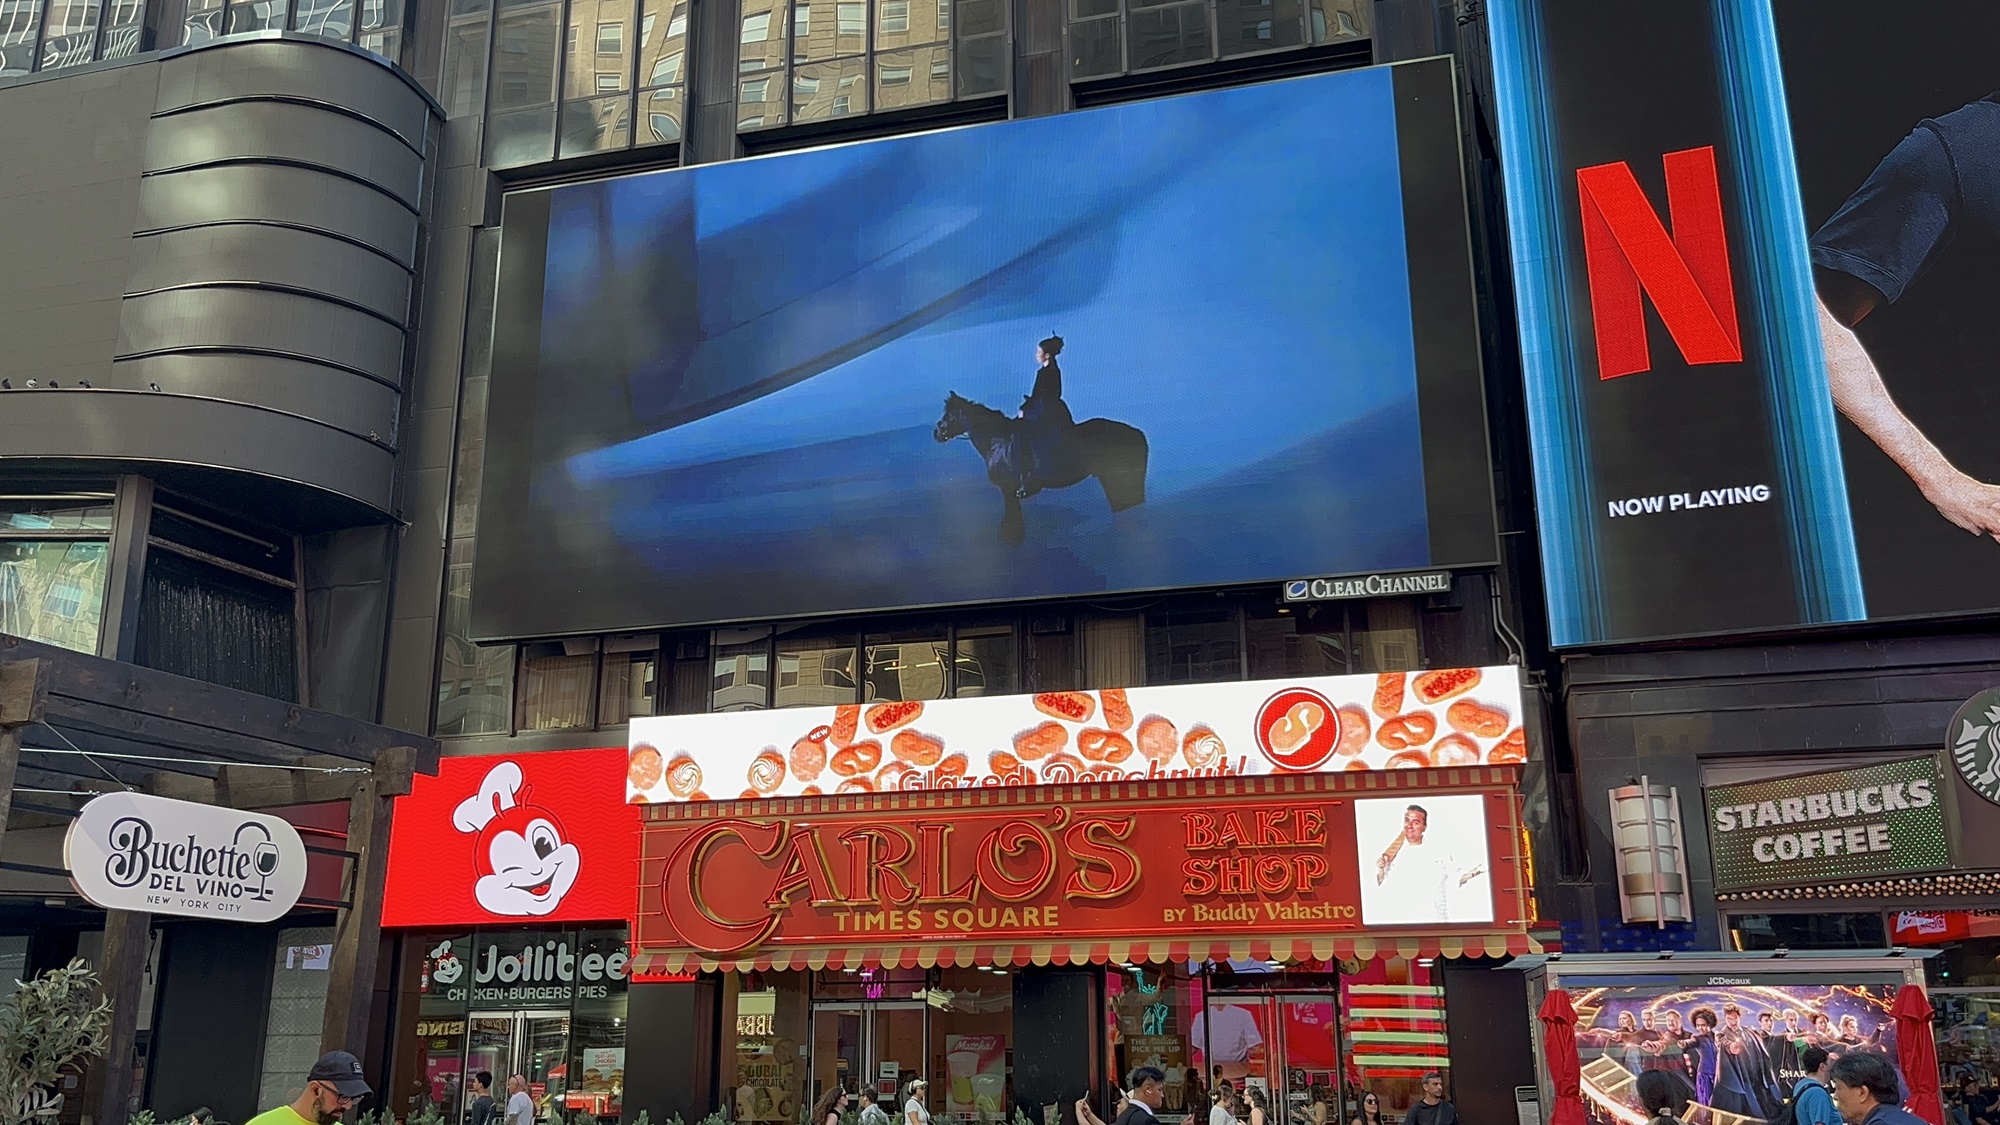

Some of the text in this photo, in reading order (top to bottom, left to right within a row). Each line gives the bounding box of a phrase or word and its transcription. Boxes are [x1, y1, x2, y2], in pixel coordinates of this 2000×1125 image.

[1608, 484, 1771, 518] NOW PLAYING
[810, 728, 828, 741] NEW
[1715, 778, 1934, 832] STARBUCKS
[1180, 806, 1328, 850] BAKE
[105, 816, 251, 888] Buchette
[1752, 822, 1892, 863] COFFEE
[149, 873, 244, 899] DEL VINO
[660, 806, 1142, 953] CARLO'S
[1180, 852, 1329, 895] SHOP
[146, 895, 243, 913] NEW YORK CITY
[1164, 901, 1356, 925] BY Buddy Valastro
[833, 906, 1058, 932] TIMES SQUARE
[475, 940, 628, 983] Jollibee
[578, 985, 608, 999] PIES
[1707, 976, 1751, 985] JCDecaux
[954, 1040, 997, 1051] Matcha!
[1131, 1045, 1181, 1053] PICK ME UP
[746, 1064, 782, 1078] DUBAI
